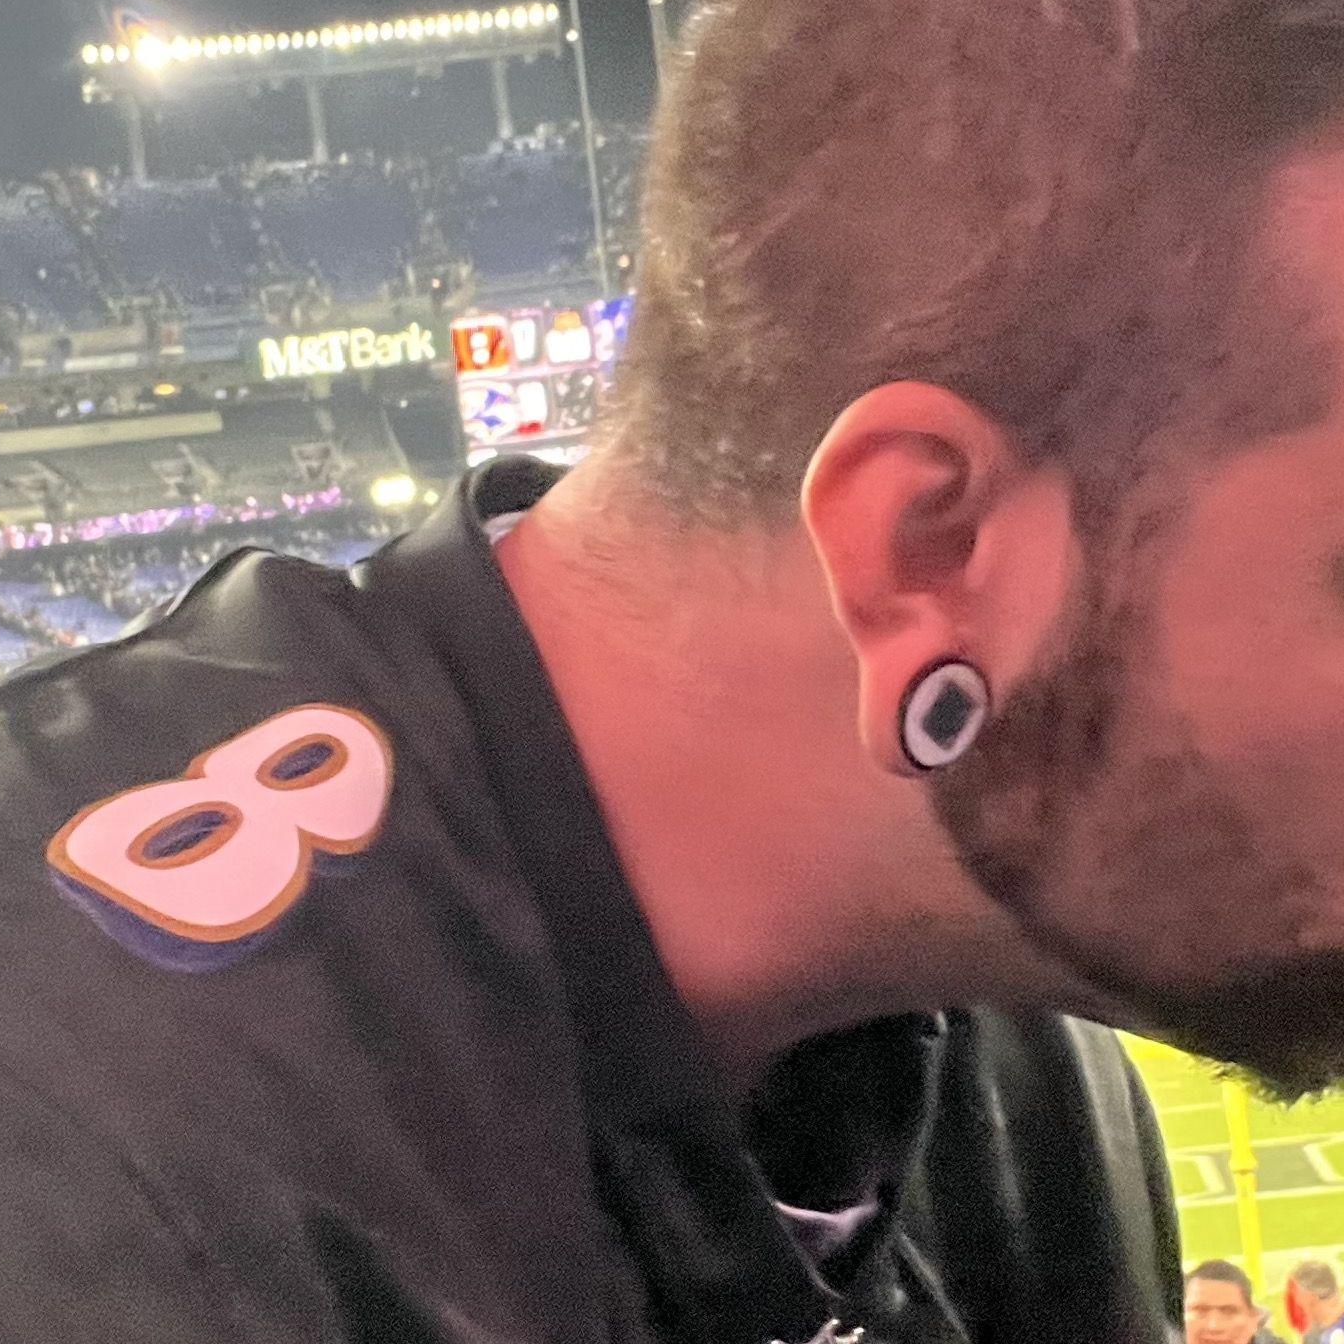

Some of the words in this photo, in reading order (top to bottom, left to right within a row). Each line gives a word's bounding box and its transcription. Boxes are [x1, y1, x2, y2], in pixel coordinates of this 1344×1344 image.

[258, 329, 348, 381] M&T
[350, 321, 436, 368] Bank
[46, 702, 394, 944] 8
